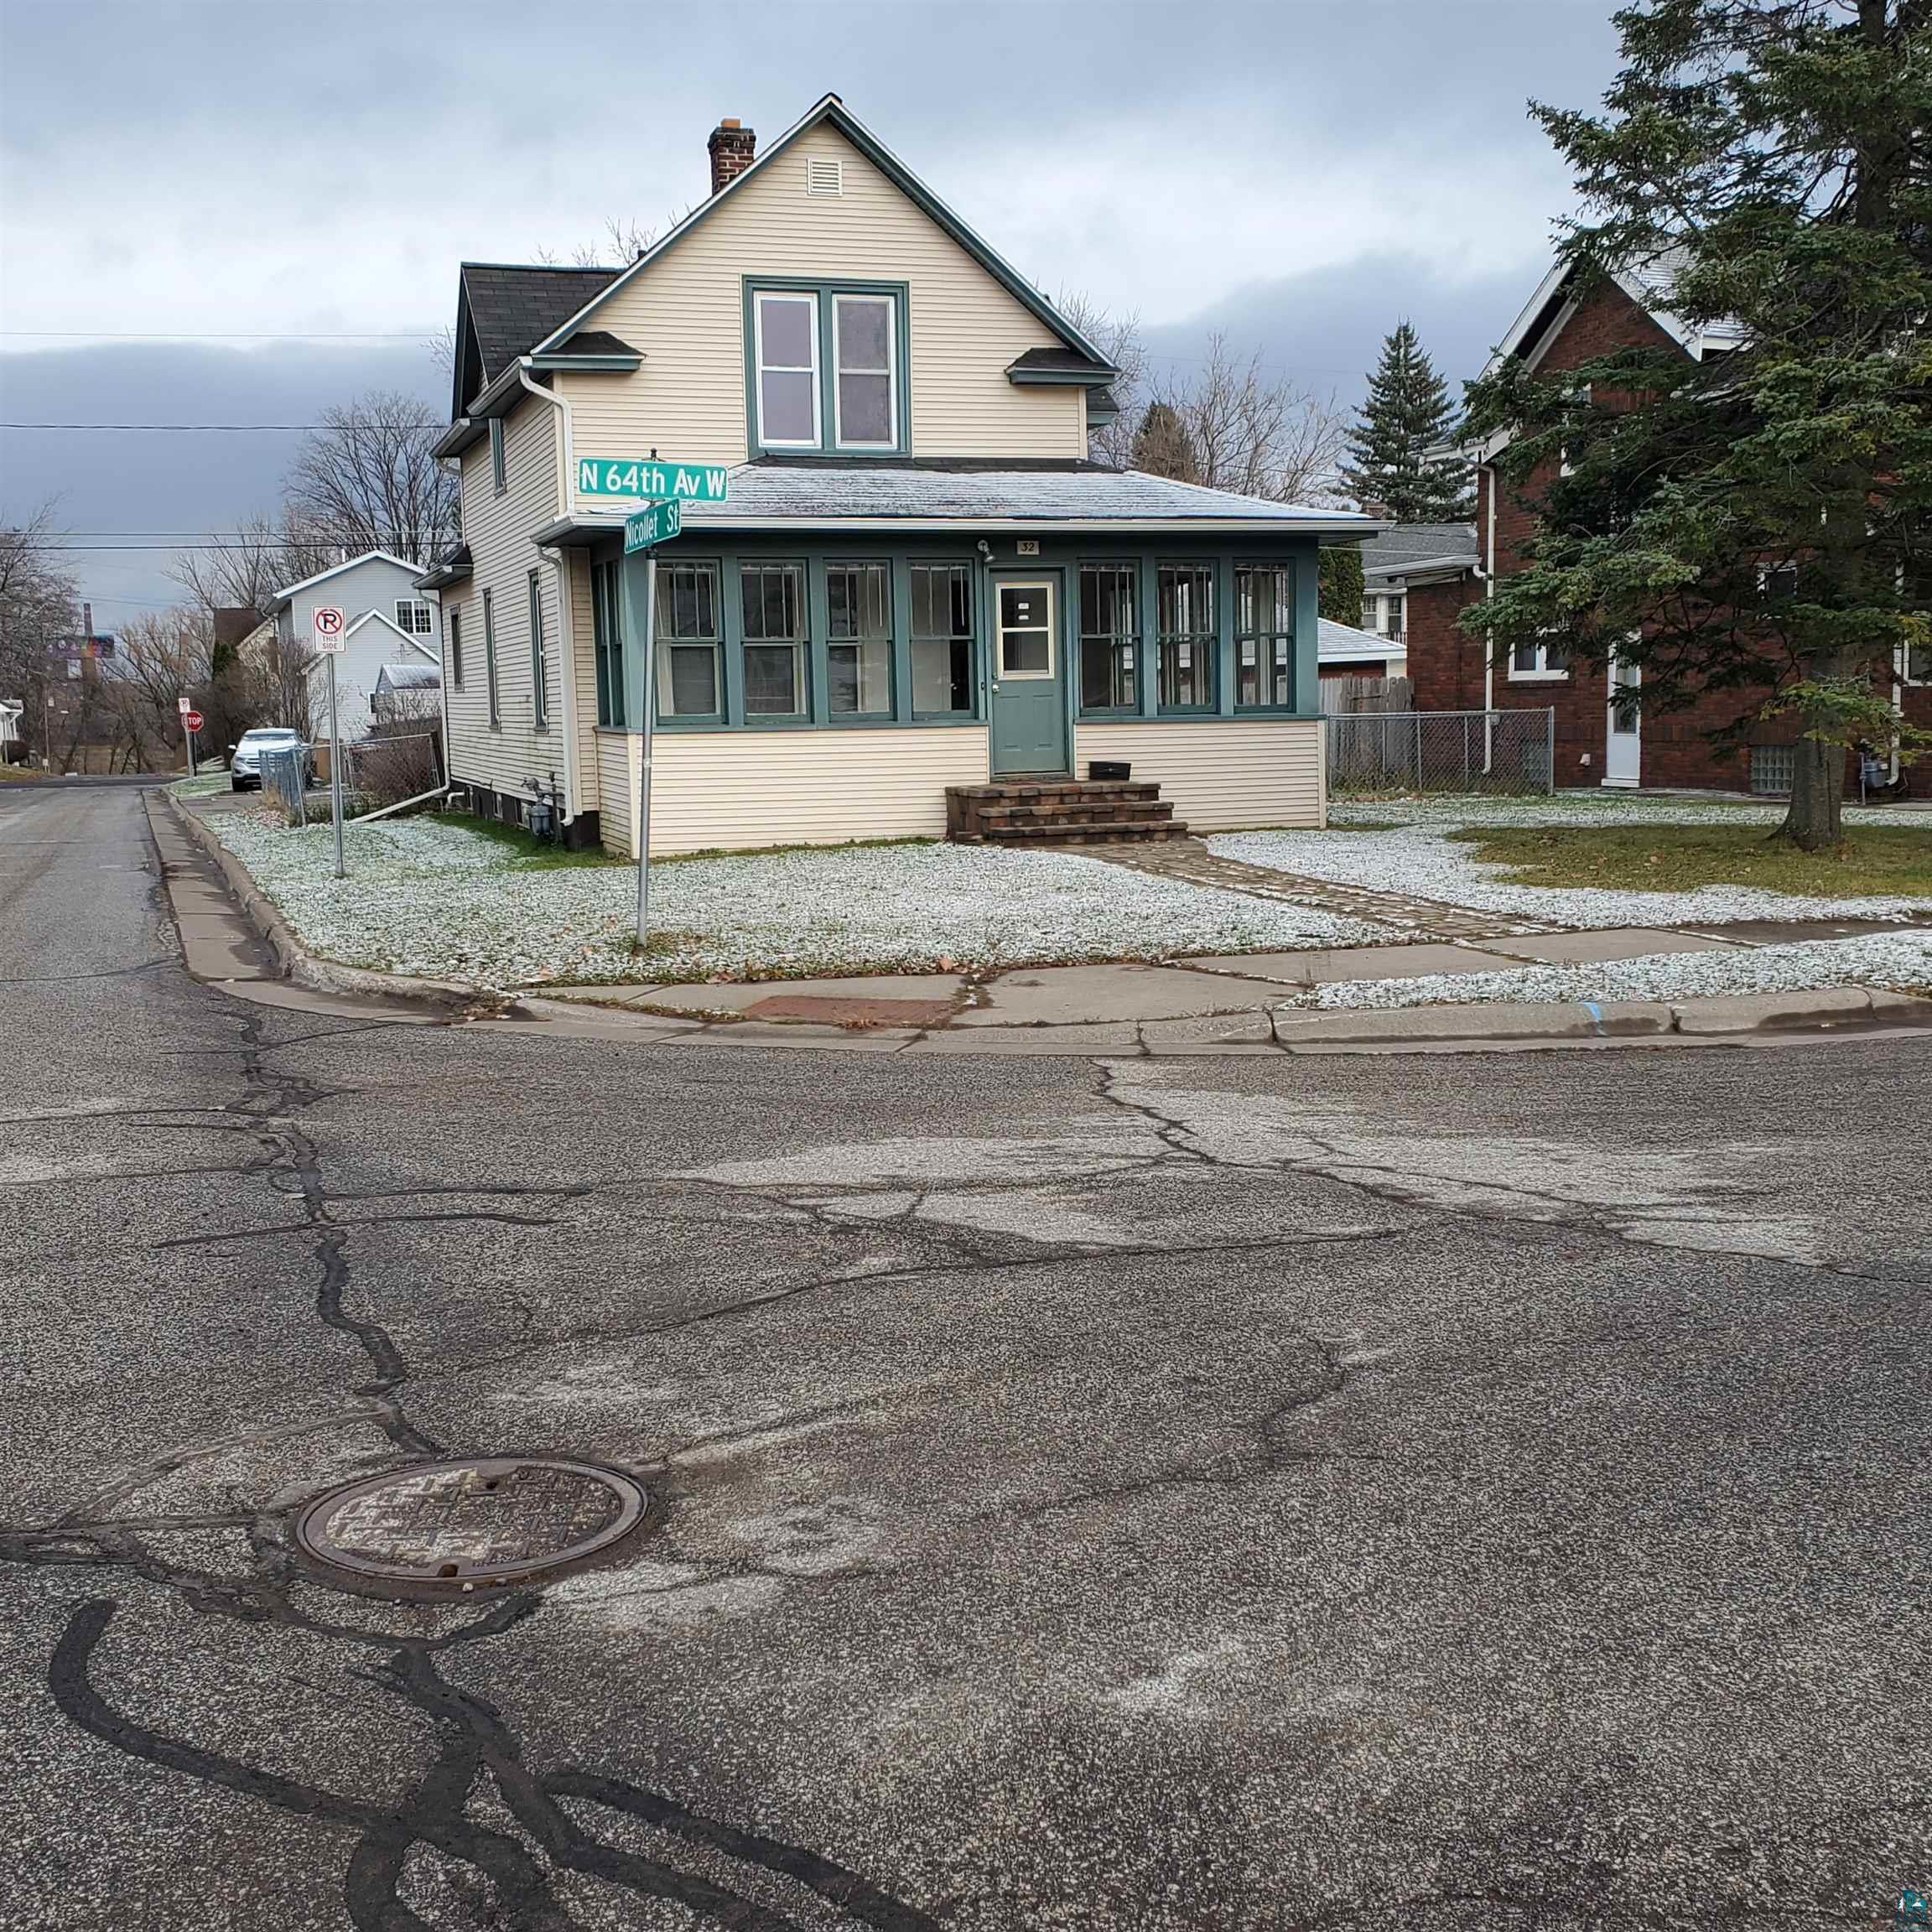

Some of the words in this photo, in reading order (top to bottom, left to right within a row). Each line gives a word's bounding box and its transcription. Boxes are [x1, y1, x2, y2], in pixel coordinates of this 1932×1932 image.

[581, 462, 598, 490] N
[605, 463, 665, 495] 64th
[673, 468, 701, 496] Av
[705, 470, 725, 497] W
[625, 511, 658, 549] Nicollet
[666, 505, 679, 532] St
